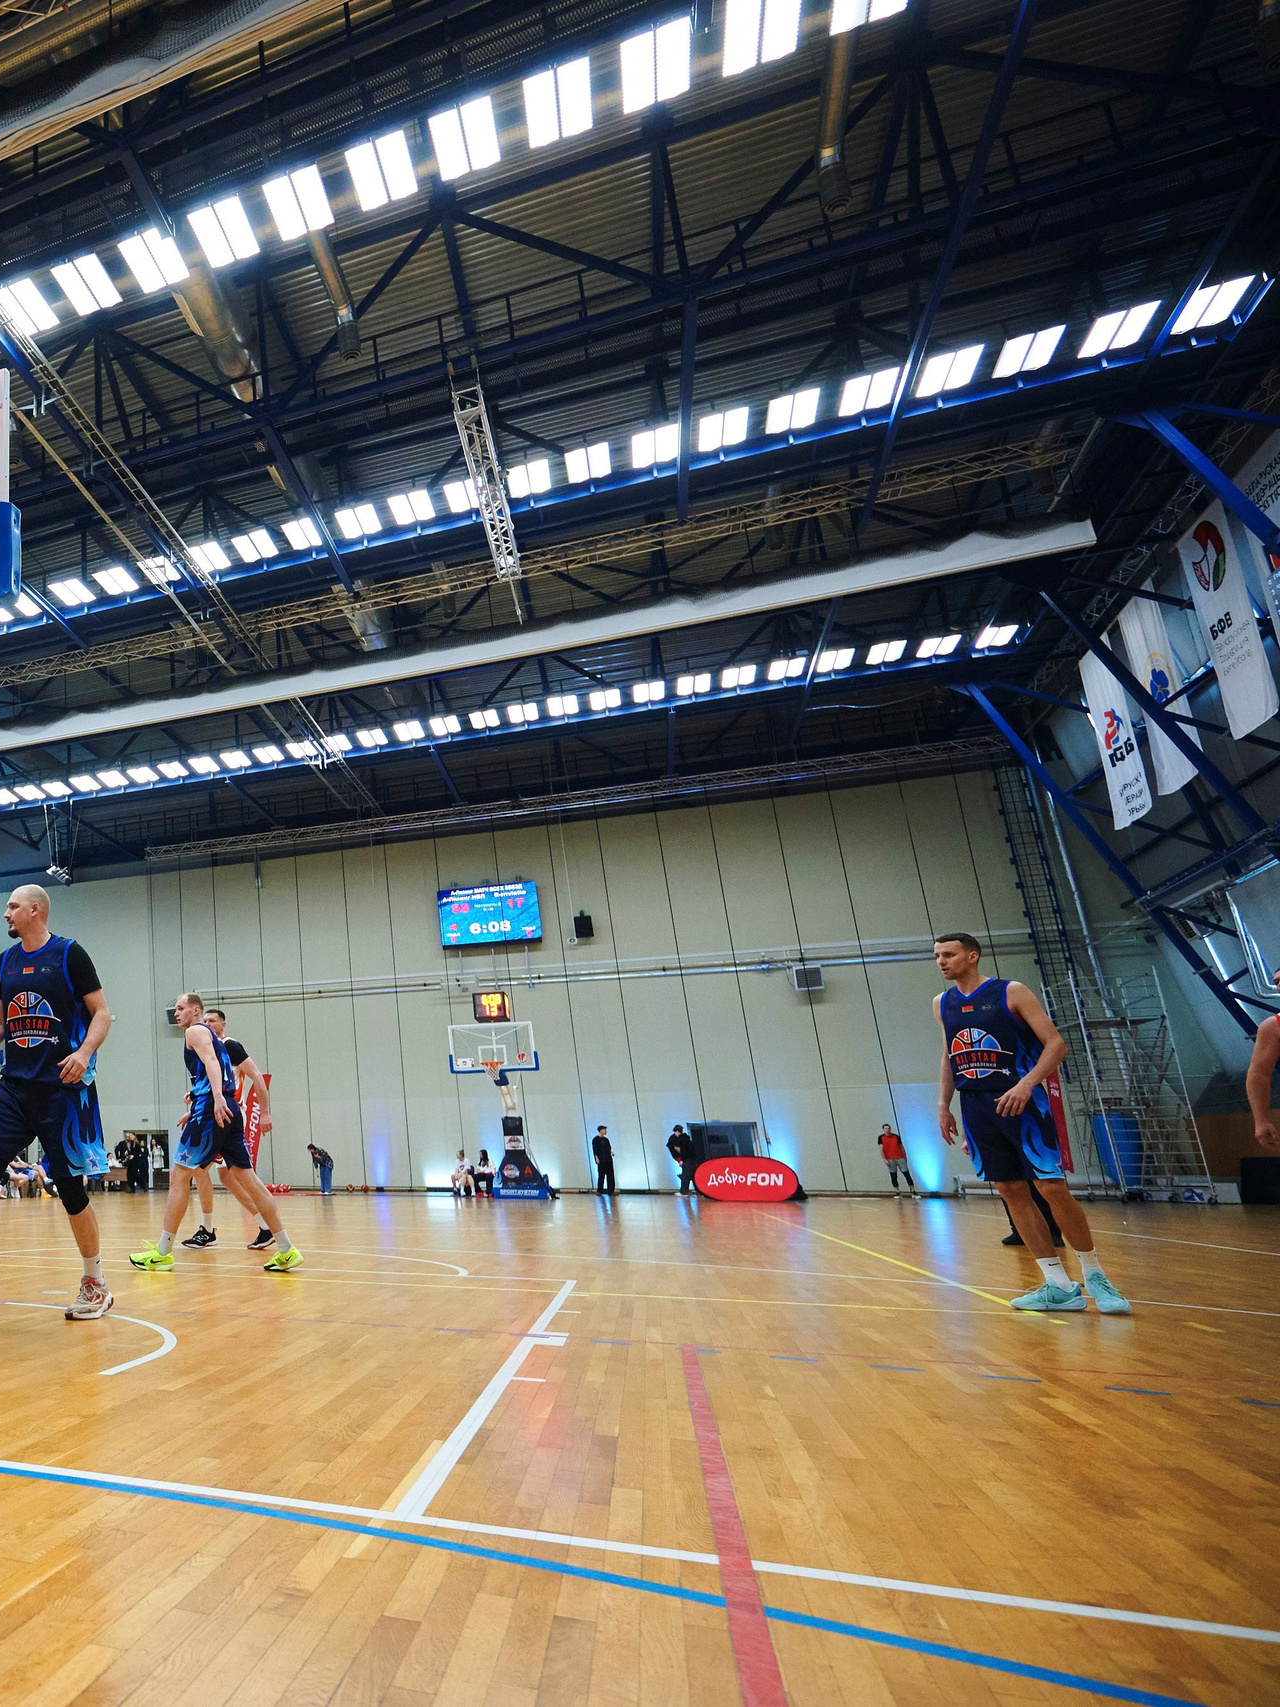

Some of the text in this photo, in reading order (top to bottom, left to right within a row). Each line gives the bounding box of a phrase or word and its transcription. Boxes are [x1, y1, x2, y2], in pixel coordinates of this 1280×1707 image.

[506, 897, 524, 909] 17
[469, 920, 511, 935] 6:08
[486, 1004, 498, 1017] 13
